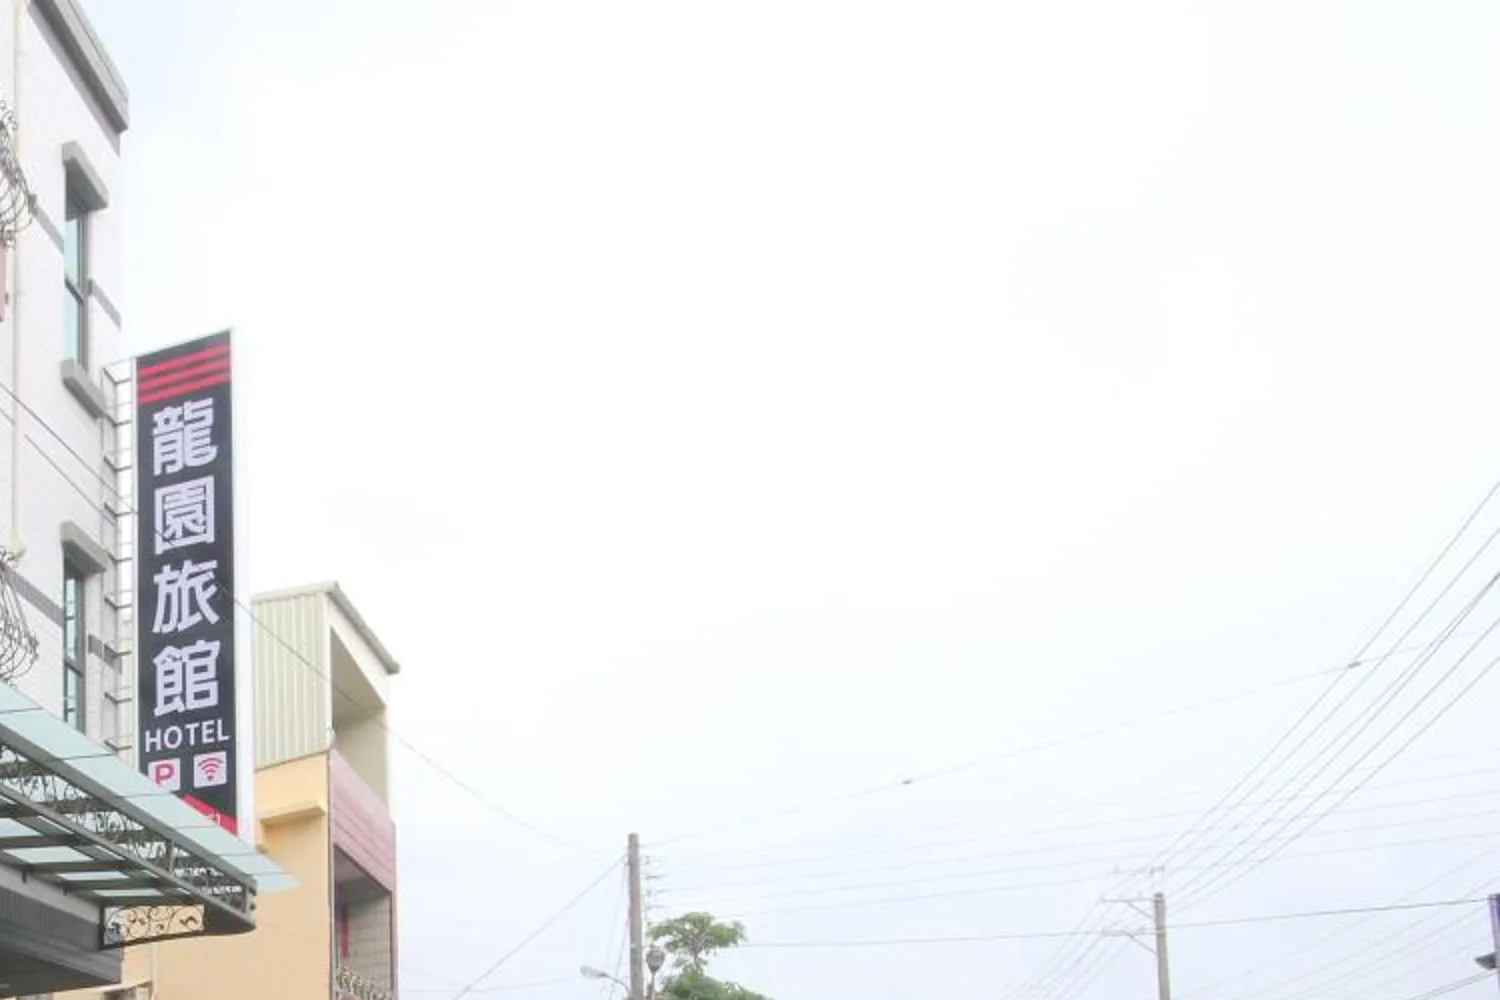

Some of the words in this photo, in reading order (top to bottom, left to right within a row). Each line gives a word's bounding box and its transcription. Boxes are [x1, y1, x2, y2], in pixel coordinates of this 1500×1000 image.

[152, 398, 220, 718] 龍園旅館
[145, 719, 230, 752] HOTEL
[155, 763, 174, 785] P
